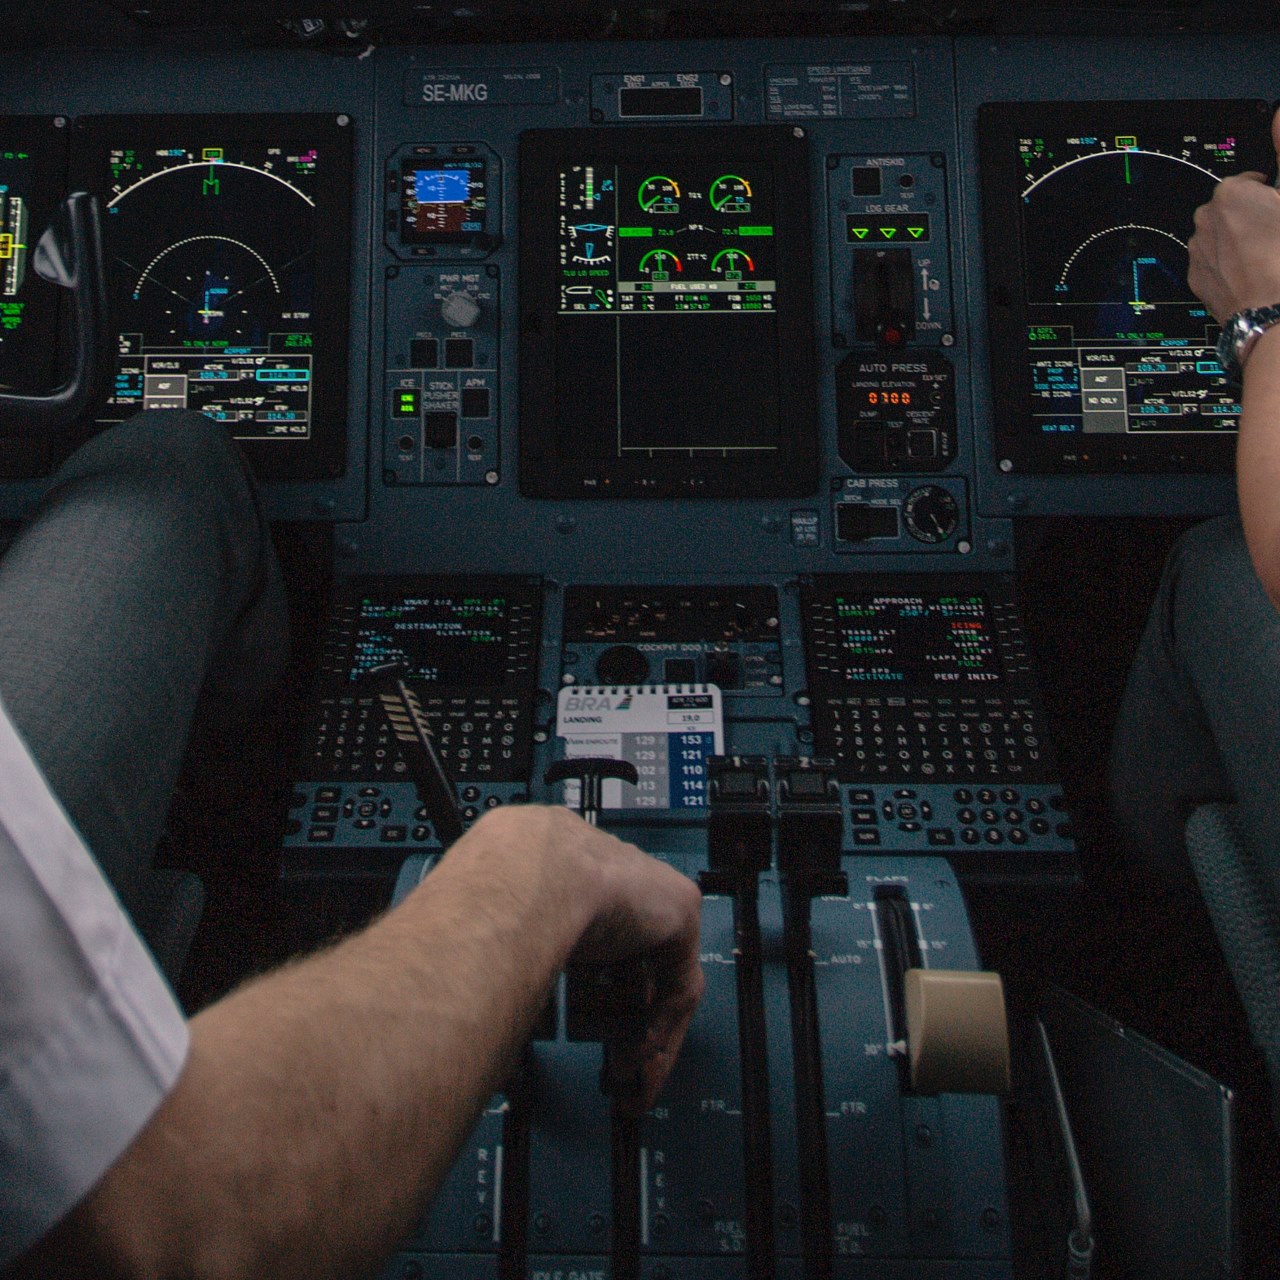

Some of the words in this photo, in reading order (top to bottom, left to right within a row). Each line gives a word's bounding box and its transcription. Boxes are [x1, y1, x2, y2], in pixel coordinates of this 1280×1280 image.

[422, 83, 489, 103] SE-MKG
[866, 158, 906, 167] ANTISKID
[865, 205, 882, 213] LDG
[884, 204, 910, 213] GEAR
[917, 259, 932, 267] UP
[915, 322, 943, 330] DOWN
[858, 363, 888, 373] AUTO
[891, 363, 929, 373] PRESS
[400, 378, 416, 387] ICE
[429, 381, 454, 390] STICK
[851, 381, 880, 389] LANDING
[423, 391, 459, 401] PUSHER
[423, 401, 459, 411] SHAKER
[846, 479, 867, 488] CAB
[868, 479, 900, 488] PRESS
[873, 597, 924, 605] APPROACH
[394, 622, 464, 631] DESTINATION
[951, 622, 984, 630] ICING
[636, 643, 679, 652] COCKPIT
[957, 660, 984, 668] FULL
[934, 673, 961, 681] PERF
[564, 697, 613, 711] BRA
[635, 736, 656, 745] 129
[680, 735, 703, 745] 153
[635, 751, 657, 760] 129
[681, 750, 703, 760] 121
[682, 765, 704, 775] 110
[682, 781, 704, 791] 114
[635, 796, 657, 806] 129
[682, 796, 705, 806] 121
[866, 875, 910, 883] FLAPS
[830, 954, 863, 965] AUTO
